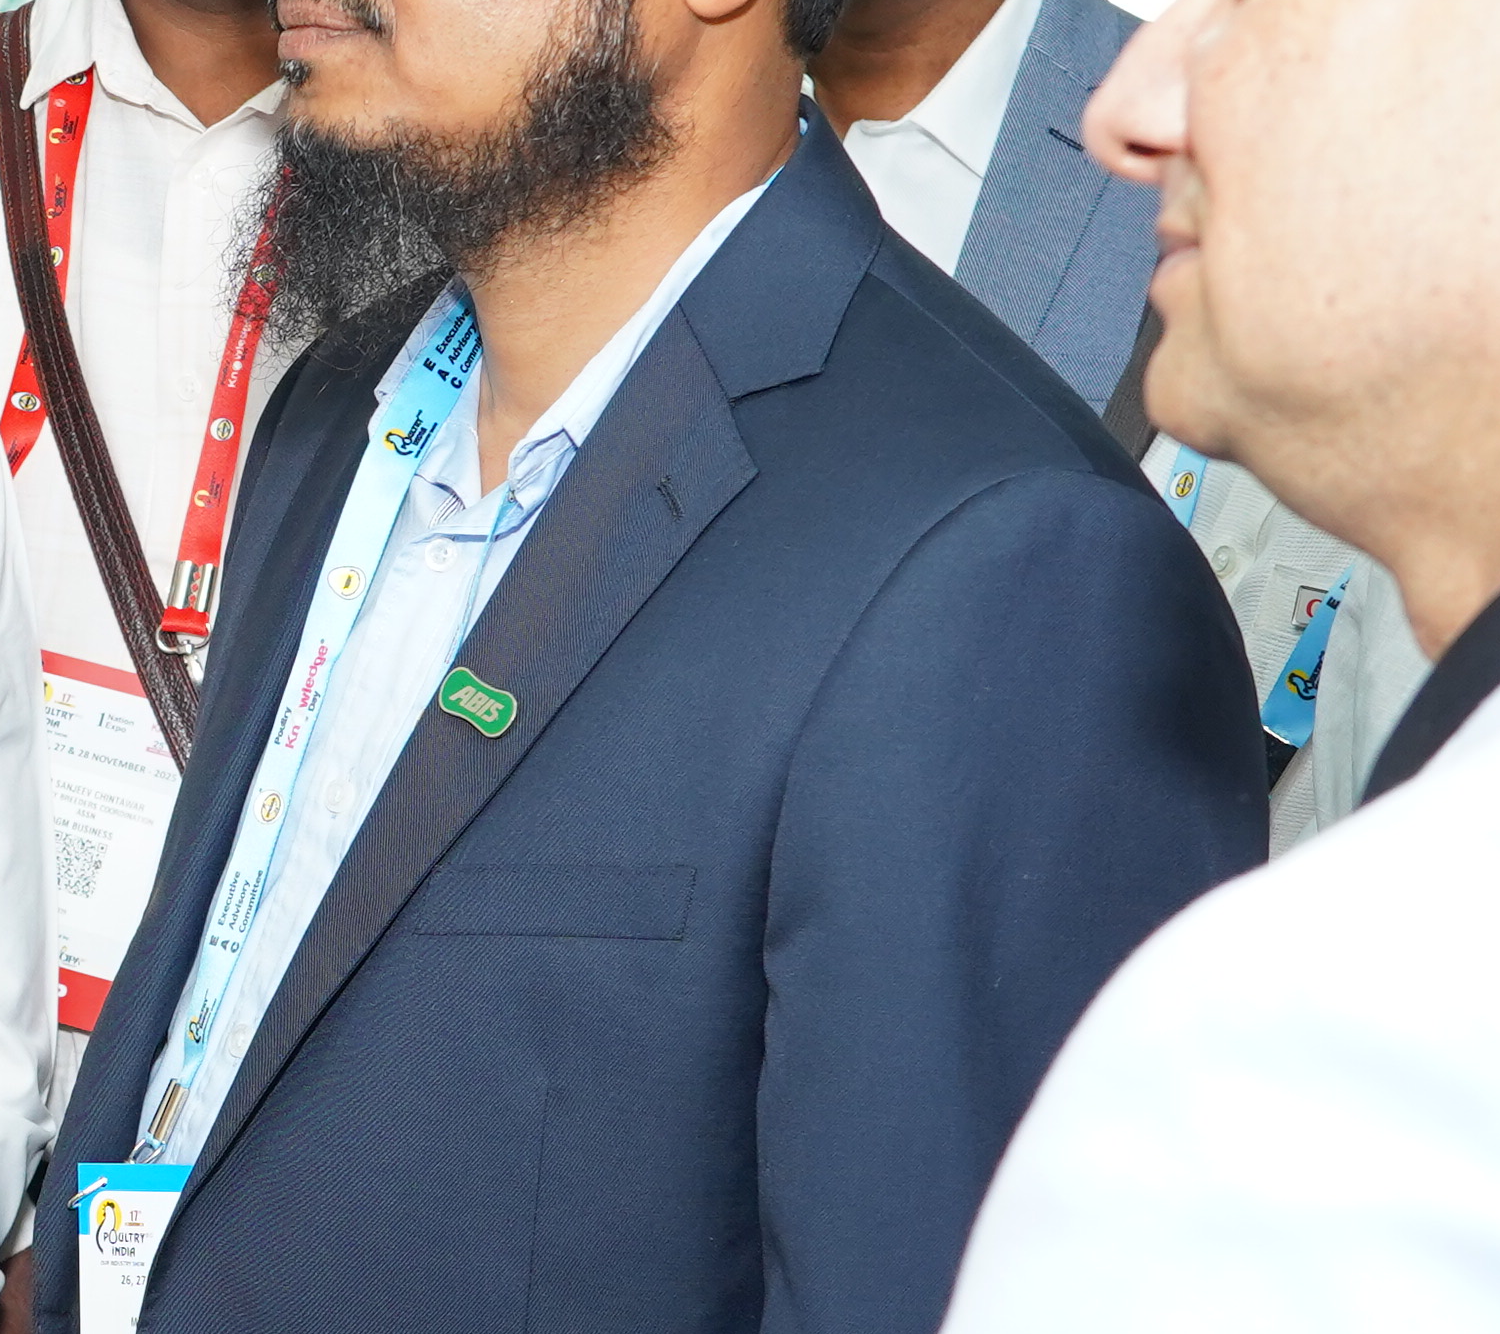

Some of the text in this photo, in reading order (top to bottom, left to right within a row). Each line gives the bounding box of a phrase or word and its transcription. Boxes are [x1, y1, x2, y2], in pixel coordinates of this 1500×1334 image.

[435, 307, 471, 355] Executive
[448, 322, 477, 365] Advisory
[285, 645, 328, 749] Knwledge
[448, 685, 505, 723] ABIS
[54, 743, 66, 752] 27
[78, 749, 90, 759] 28
[91, 753, 146, 774] NOVEMBER
[217, 870, 241, 926] Executive
[228, 879, 251, 930] Advisory
[238, 869, 264, 934] Committee
[103, 1228, 145, 1245] POULTRY
[111, 1247, 136, 1257] INDIA
[121, 1275, 134, 1286] 26,
